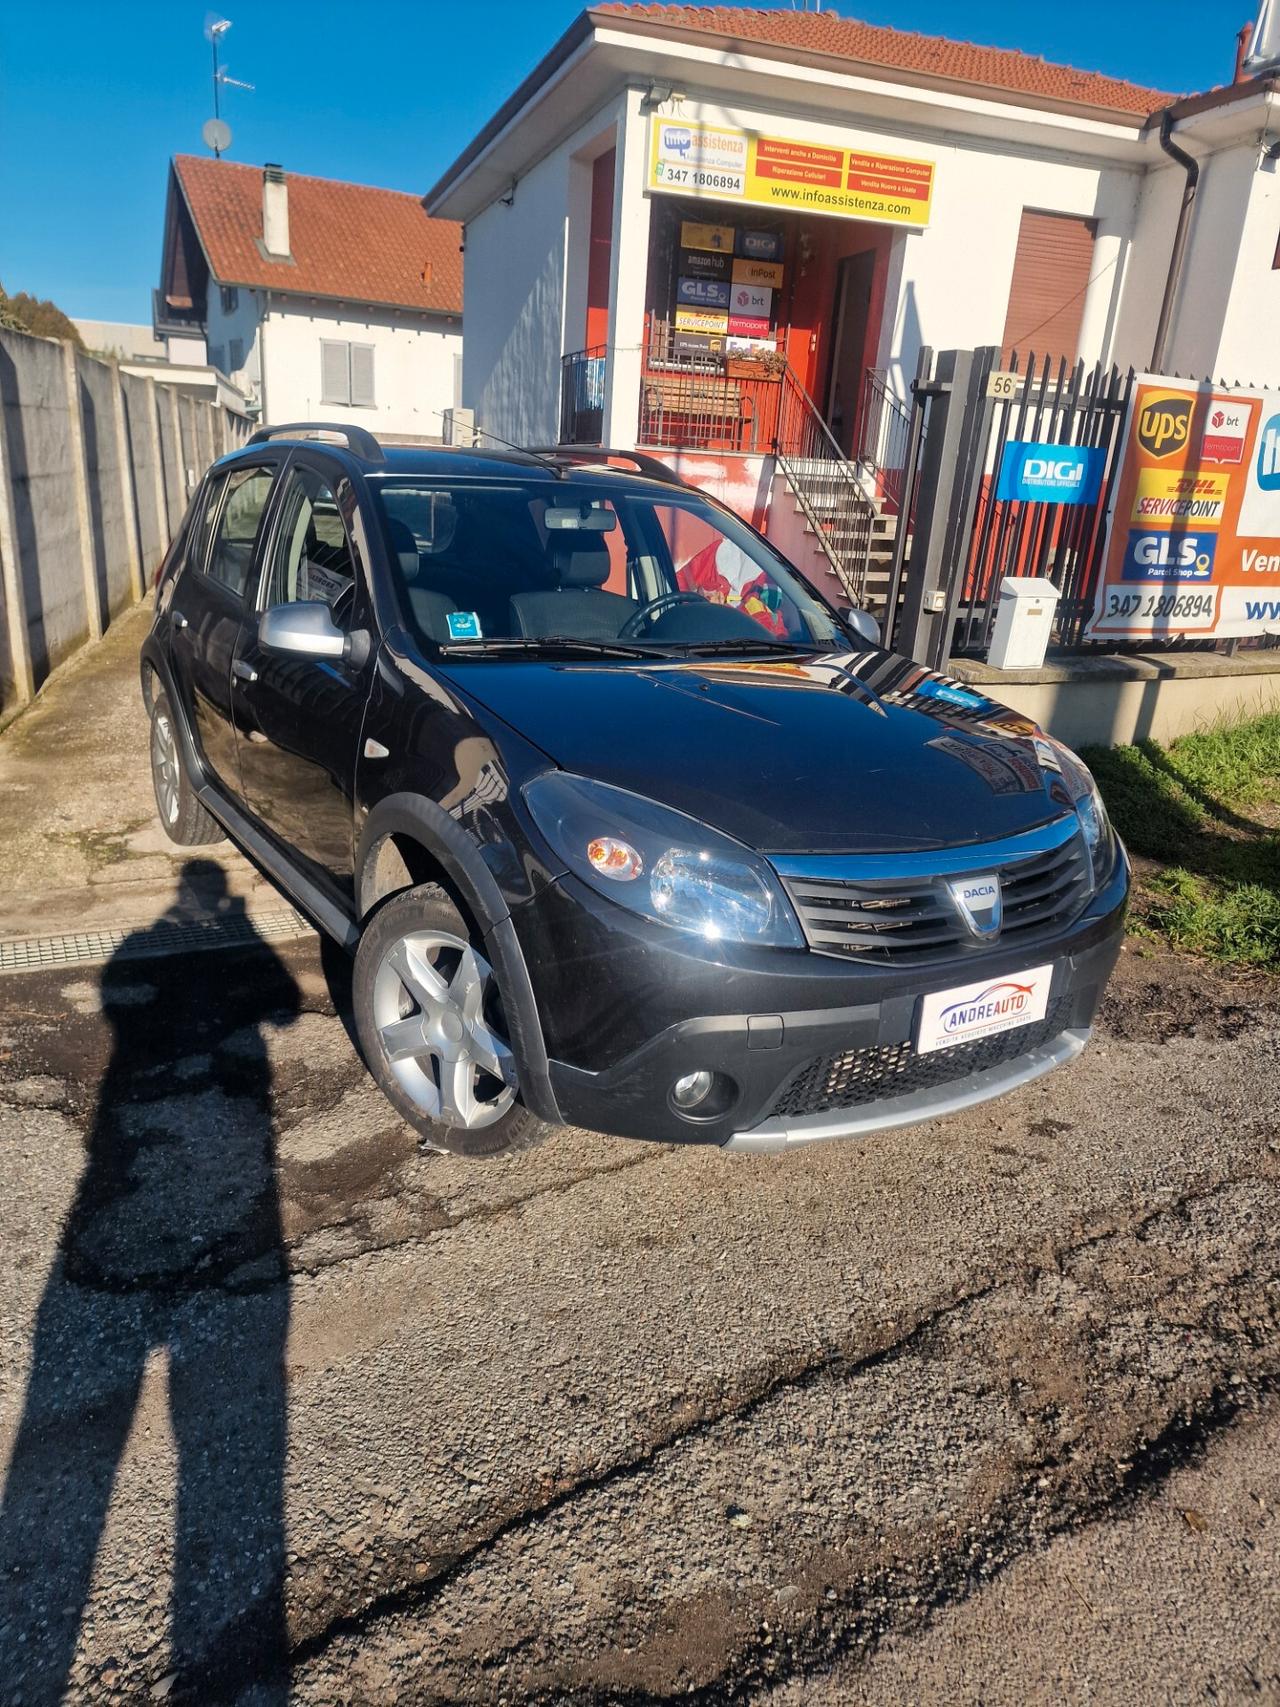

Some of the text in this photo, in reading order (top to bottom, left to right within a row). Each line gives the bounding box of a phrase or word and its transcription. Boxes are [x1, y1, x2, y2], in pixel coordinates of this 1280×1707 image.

[692, 134, 743, 153] assistenza
[764, 144, 790, 155] Interventi
[812, 152, 837, 163] Domicilio
[772, 165, 804, 178] Riparazione
[851, 157, 870, 168] Vendita
[875, 161, 905, 174] Riparazione
[667, 169, 740, 189] 347 1806894
[771, 186, 911, 215] www.infoassistenza.com
[687, 255, 725, 269] amazon hub
[751, 268, 776, 279] InPost
[681, 281, 718, 298] GLS
[752, 295, 765, 306] brt
[679, 317, 725, 329] SERVICEPOINT
[993, 376, 1011, 394] 56
[1226, 415, 1239, 427] brt
[1023, 459, 1084, 481] DIGI
[1175, 478, 1216, 495] DHL
[1137, 497, 1221, 518] SERVICEPOINT
[1134, 536, 1198, 566] GLS
[1148, 568, 1193, 578] Parcel Shop
[1107, 594, 1213, 619] 347 1806894
[964, 885, 996, 899] DACIA
[949, 994, 1025, 1028] ANDREAUTO
